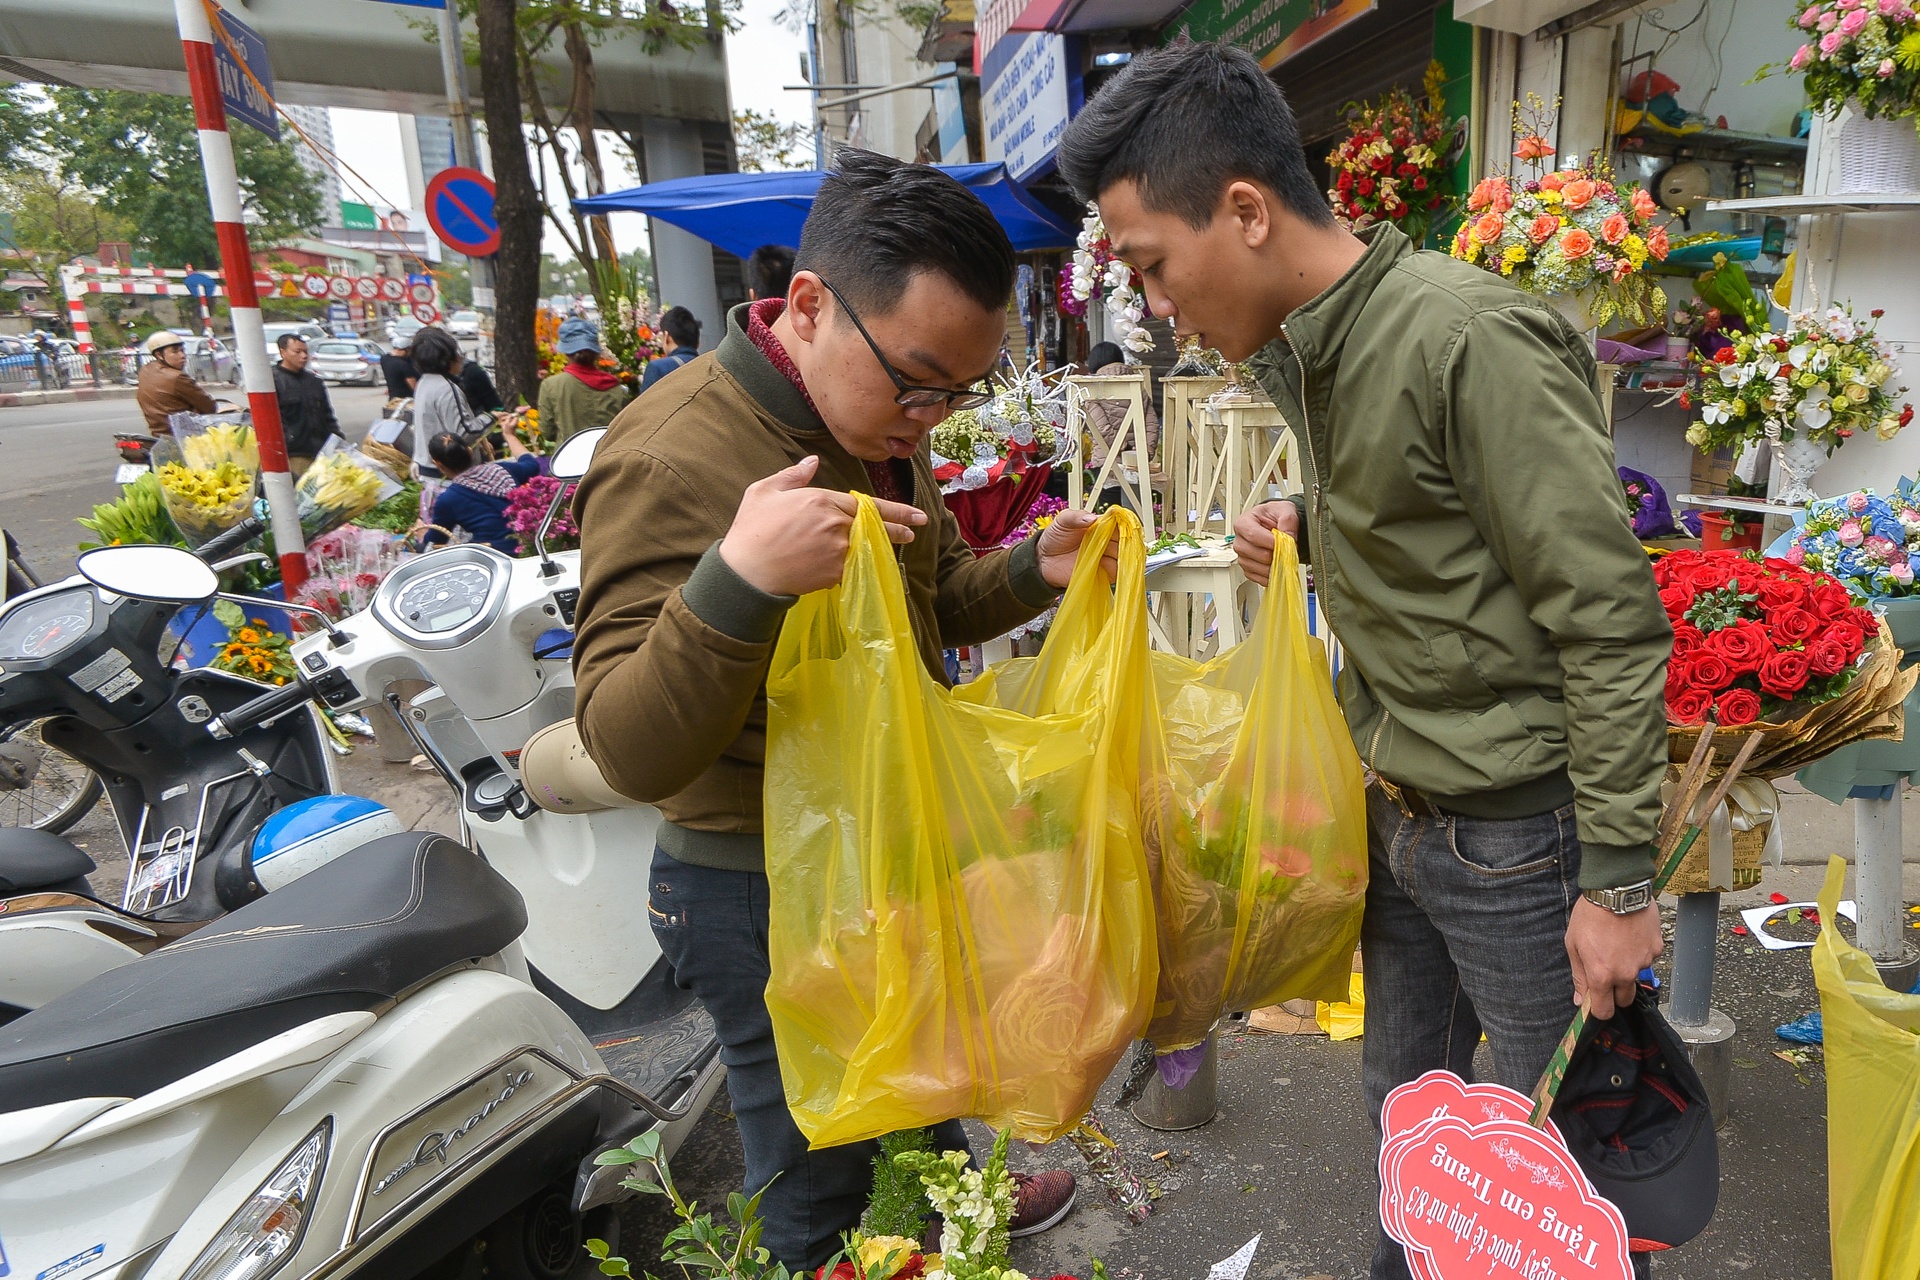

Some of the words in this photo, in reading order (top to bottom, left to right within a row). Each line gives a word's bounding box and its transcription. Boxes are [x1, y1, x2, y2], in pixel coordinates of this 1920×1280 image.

[1430, 1142, 1494, 1206] Trang
[1405, 1185, 1430, 1220] 8/3
[1425, 1196, 1449, 1226] nữ
[1500, 1187, 1534, 1221] em
[1446, 1202, 1479, 1244] phụ
[1538, 1206, 1600, 1270] Tặng
[1466, 1225, 1489, 1262] tế
[1486, 1233, 1523, 1276] quốc
